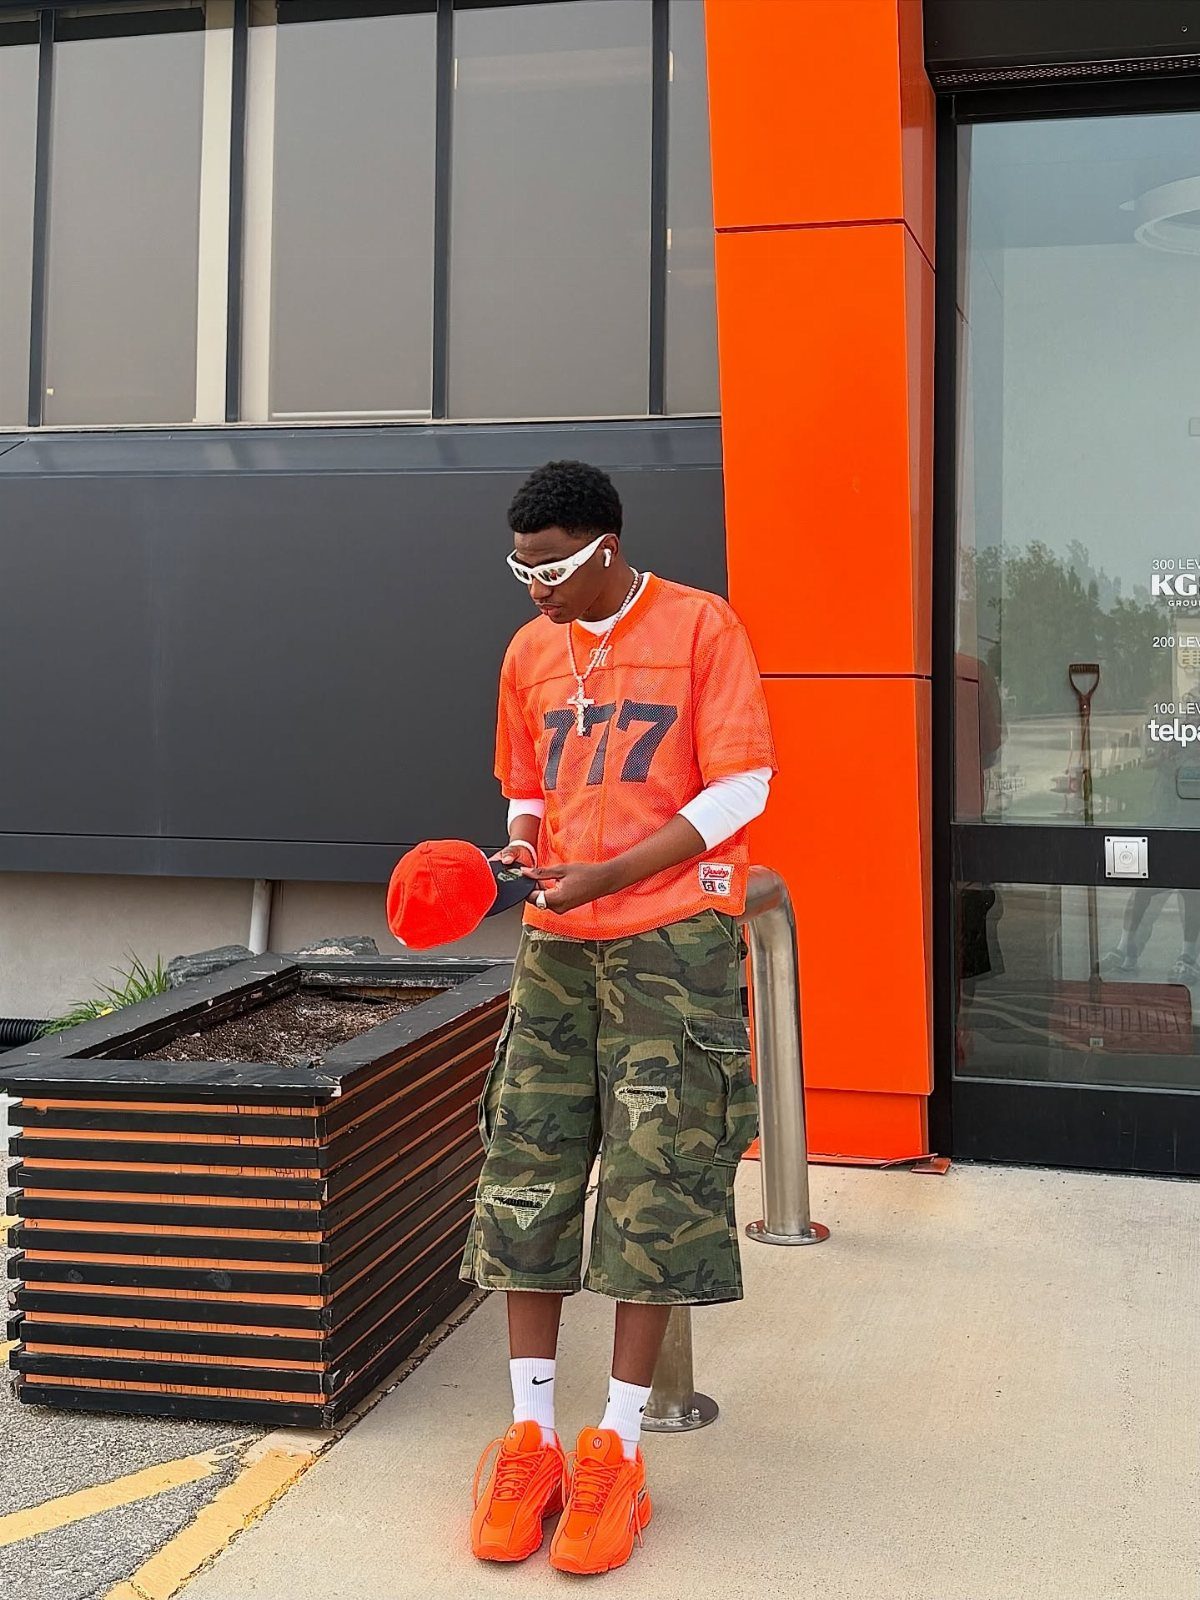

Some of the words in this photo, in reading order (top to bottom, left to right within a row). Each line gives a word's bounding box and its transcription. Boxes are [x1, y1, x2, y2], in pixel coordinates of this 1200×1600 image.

[1152, 559, 1175, 570] 300
[1168, 599, 1200, 607] GROU
[1152, 636, 1175, 648] 200
[1153, 702, 1175, 714] 100
[1147, 718, 1200, 748] telp
[543, 698, 679, 791] 777
